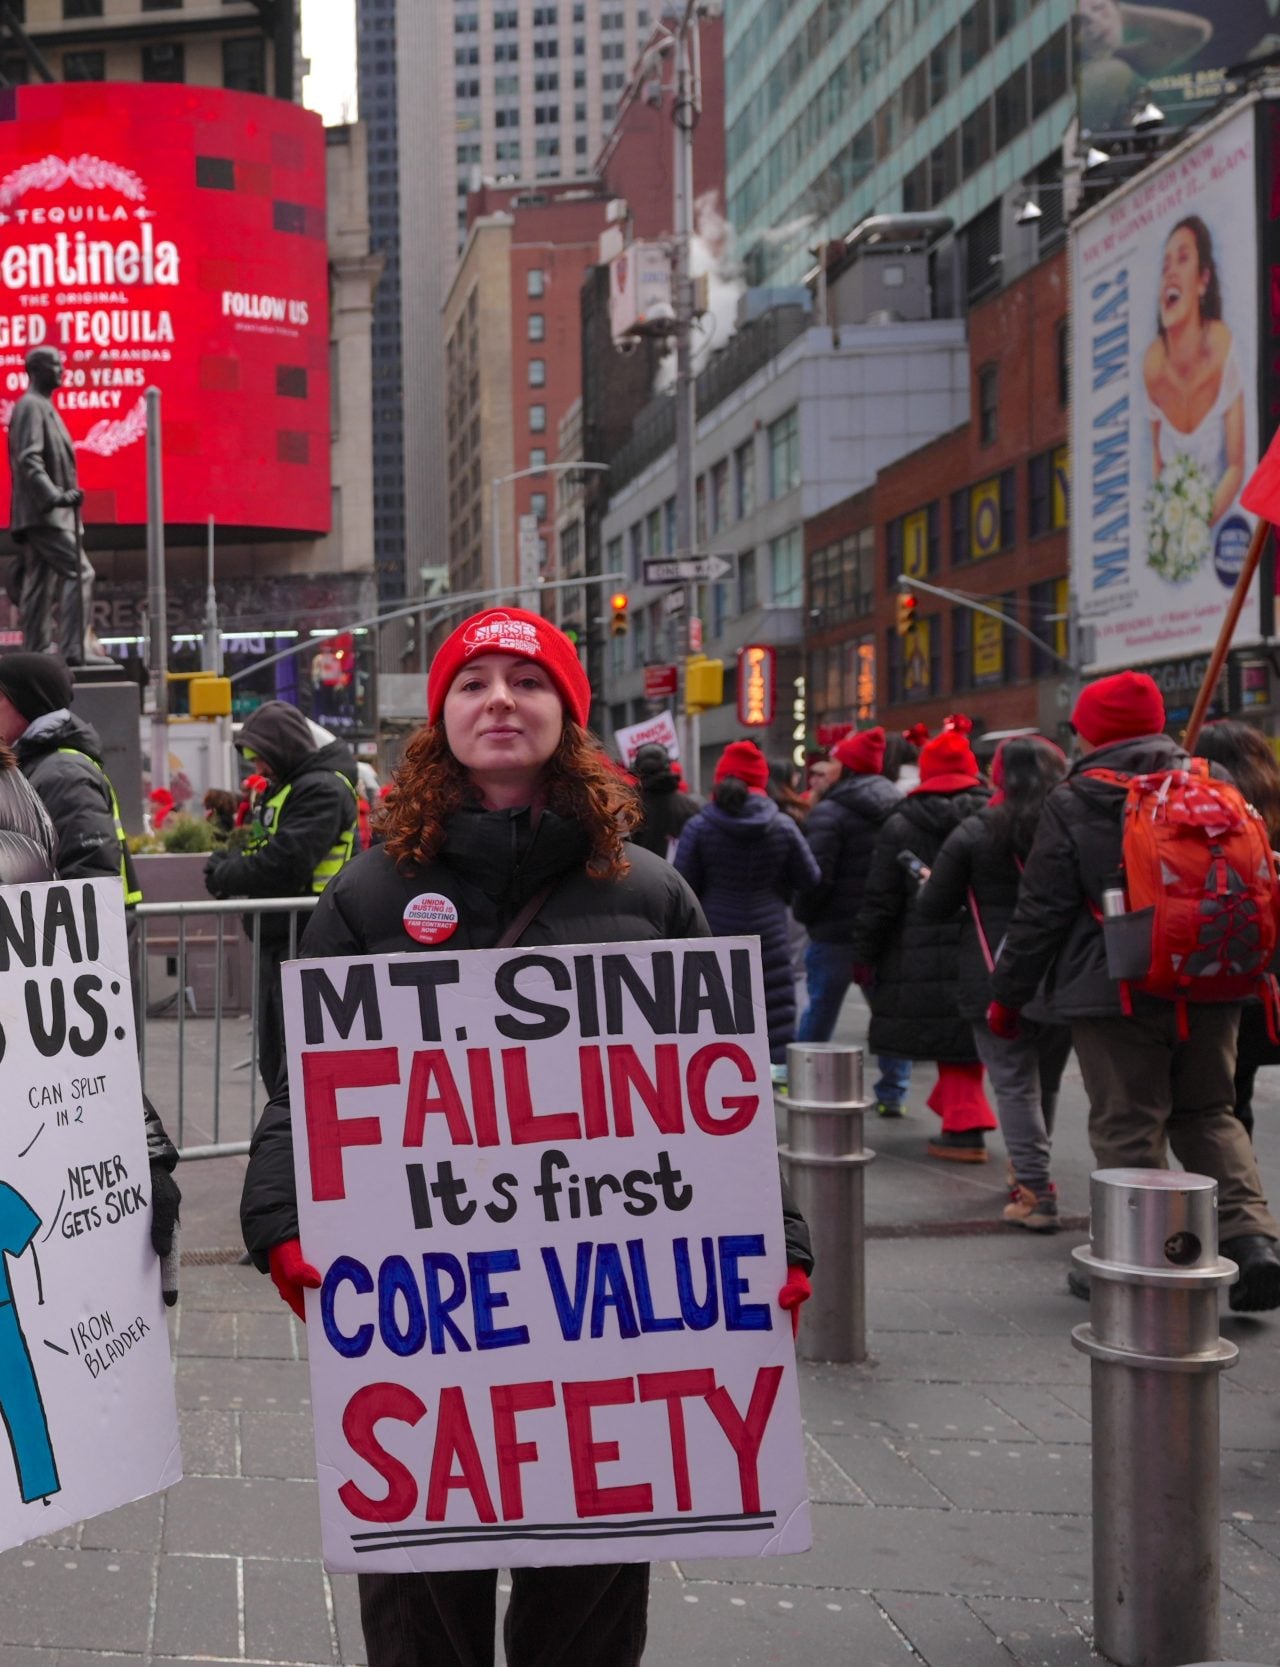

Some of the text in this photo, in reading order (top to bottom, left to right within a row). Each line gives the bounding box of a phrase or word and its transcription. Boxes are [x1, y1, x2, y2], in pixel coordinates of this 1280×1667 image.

[15, 205, 128, 225] TEQUILA
[20, 291, 128, 307] THE ORIGINAL
[222, 290, 309, 326] FOLLOW US
[56, 309, 175, 347] TEQUILA
[1091, 268, 1130, 393] MIA!
[73, 349, 94, 362] OF
[91, 367, 145, 387] YEARS
[57, 390, 122, 410] LEGACY
[1091, 396, 1131, 591] MAMMA
[475, 621, 537, 638] NURSES
[408, 911, 455, 921] DISGUSTING
[412, 905, 444, 913] BUSTING
[422, 898, 445, 906] UNION
[422, 921, 453, 929] CONTRACT
[300, 948, 756, 1045] MT. SINAI
[24, 974, 126, 1058] US:
[28, 1075, 107, 1110] CAN SPLIT
[56, 1106, 84, 1127] IN 2
[301, 1041, 760, 1202] FAILING
[67, 1154, 129, 1201] NEVER
[534, 1149, 693, 1223] first
[61, 1184, 148, 1240] GETS SICK
[320, 1233, 773, 1359] CORE VALUE
[70, 1310, 115, 1355] IRON
[84, 1316, 151, 1379] BLADDER
[337, 1364, 785, 1524] SAFETY
